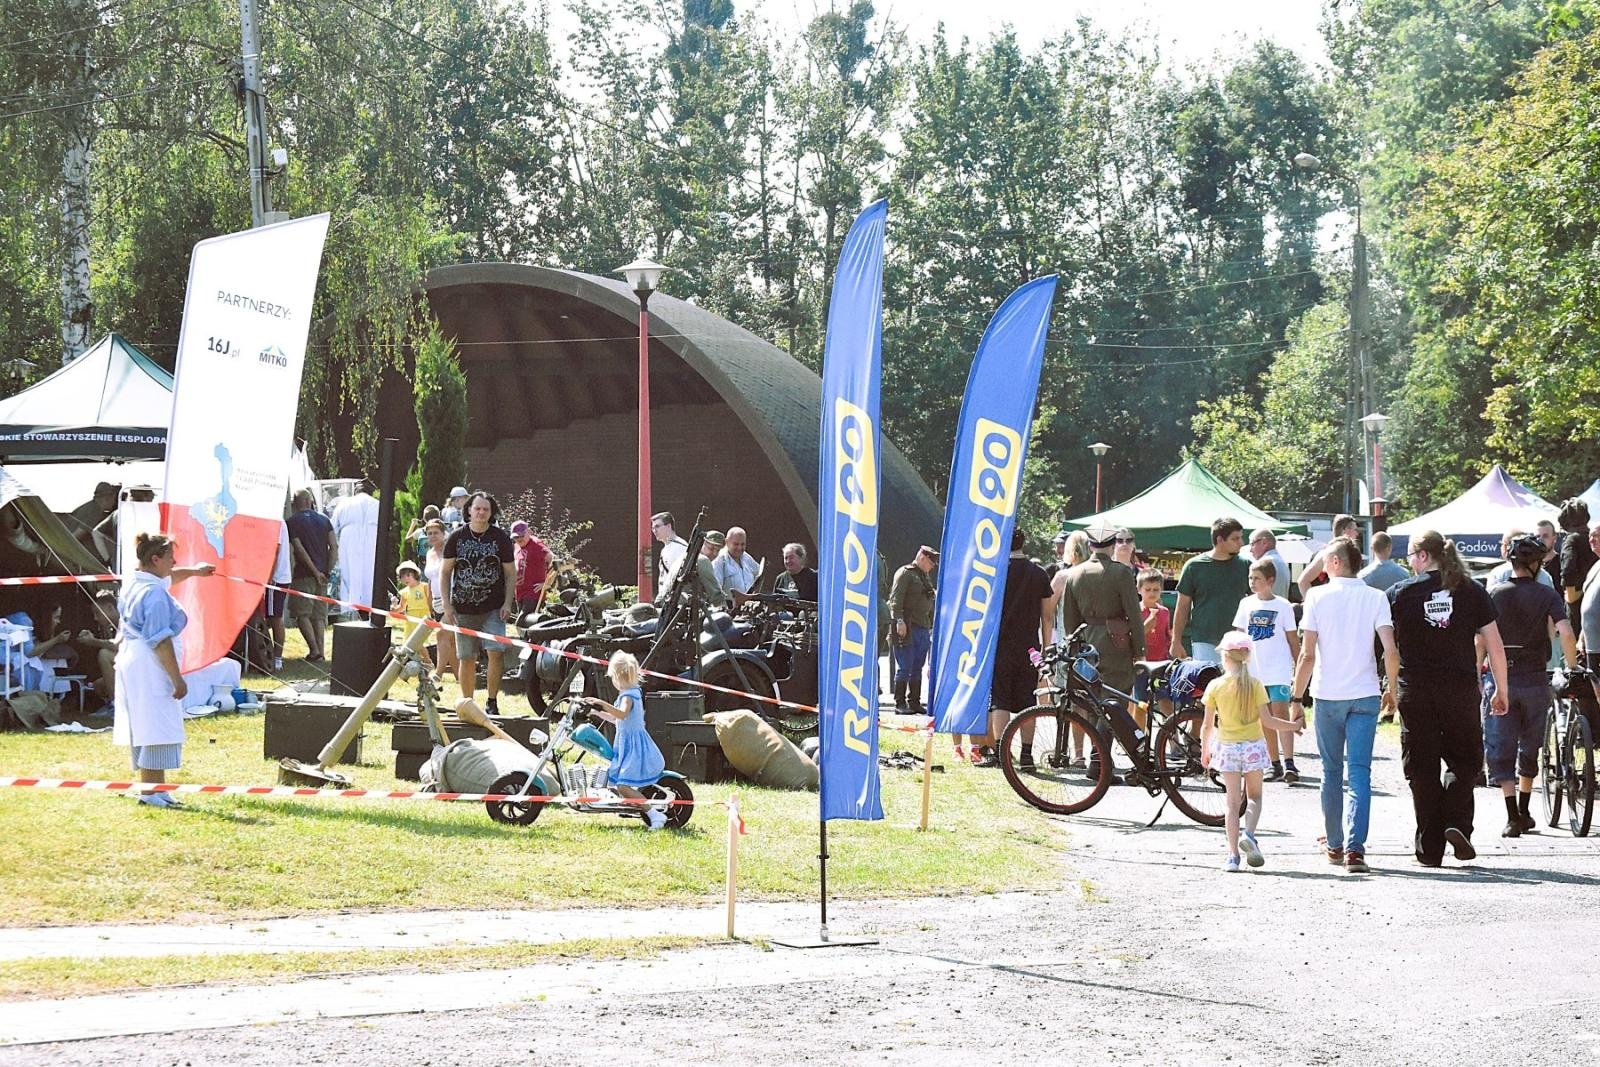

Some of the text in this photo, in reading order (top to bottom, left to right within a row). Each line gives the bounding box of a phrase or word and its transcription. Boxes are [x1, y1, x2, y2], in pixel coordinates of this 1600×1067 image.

[217, 290, 292, 321] PARTNERZY:
[259, 352, 288, 368] MITKO
[23, 433, 113, 442] STOWARZYSZENIE
[1455, 540, 1498, 553] Godów
[957, 431, 1012, 688] RADIO 90
[841, 531, 869, 755] RADIO
